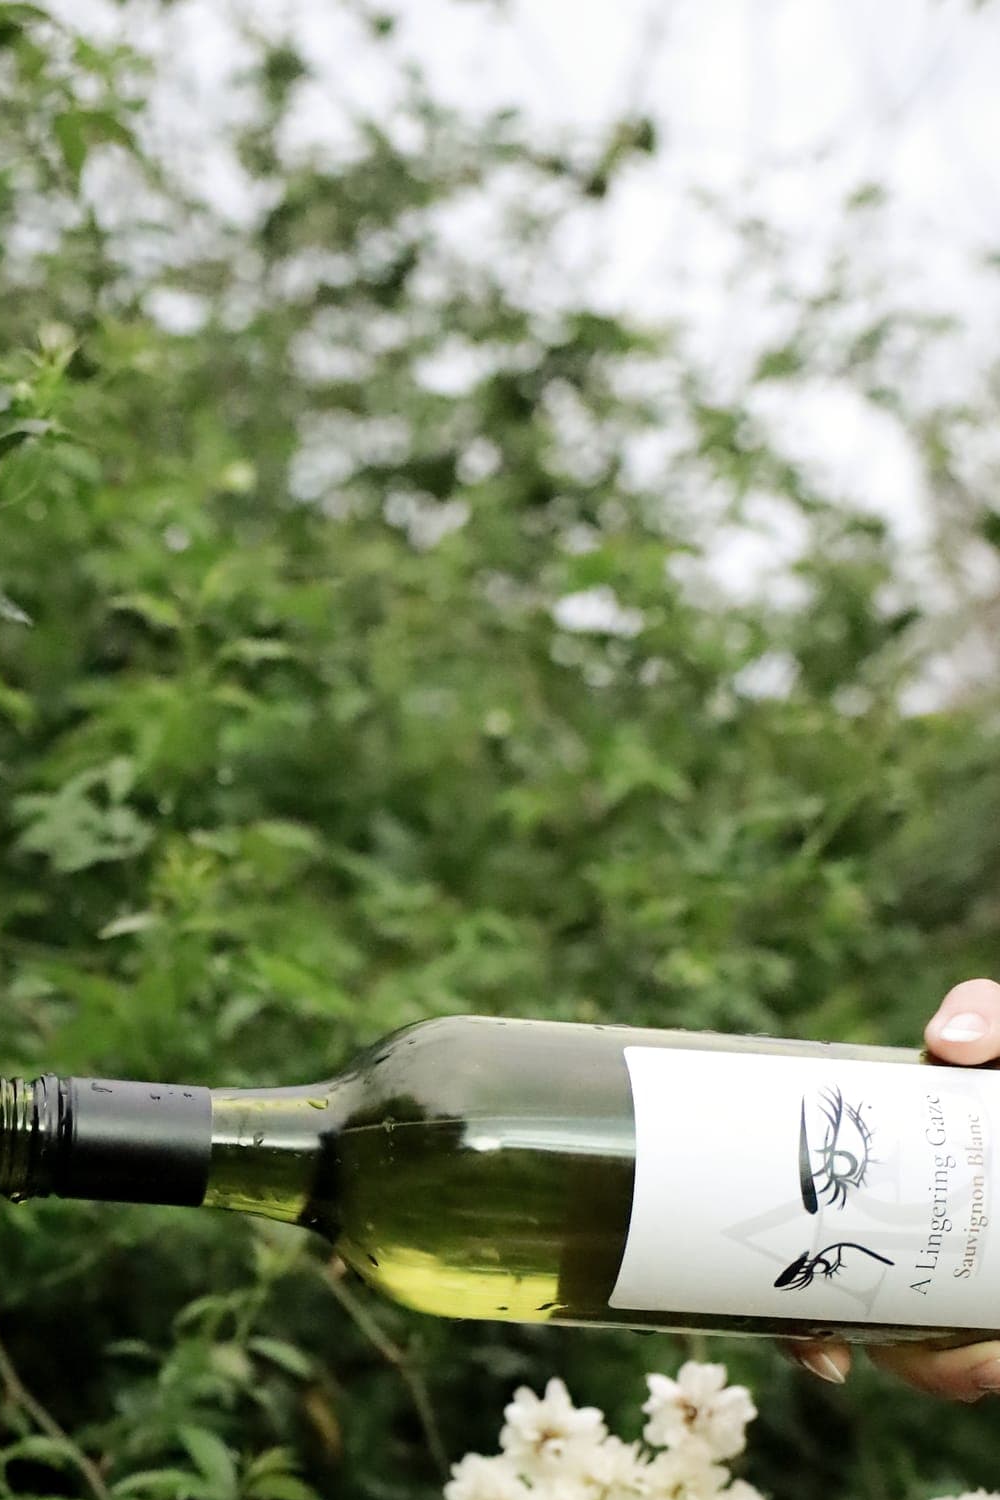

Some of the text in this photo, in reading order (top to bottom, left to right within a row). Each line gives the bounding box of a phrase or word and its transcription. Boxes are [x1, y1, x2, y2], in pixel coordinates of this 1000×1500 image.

[909, 1095, 957, 1295] A Lingering Gaze
[954, 1114, 989, 1279] Sauvignon Blanc
